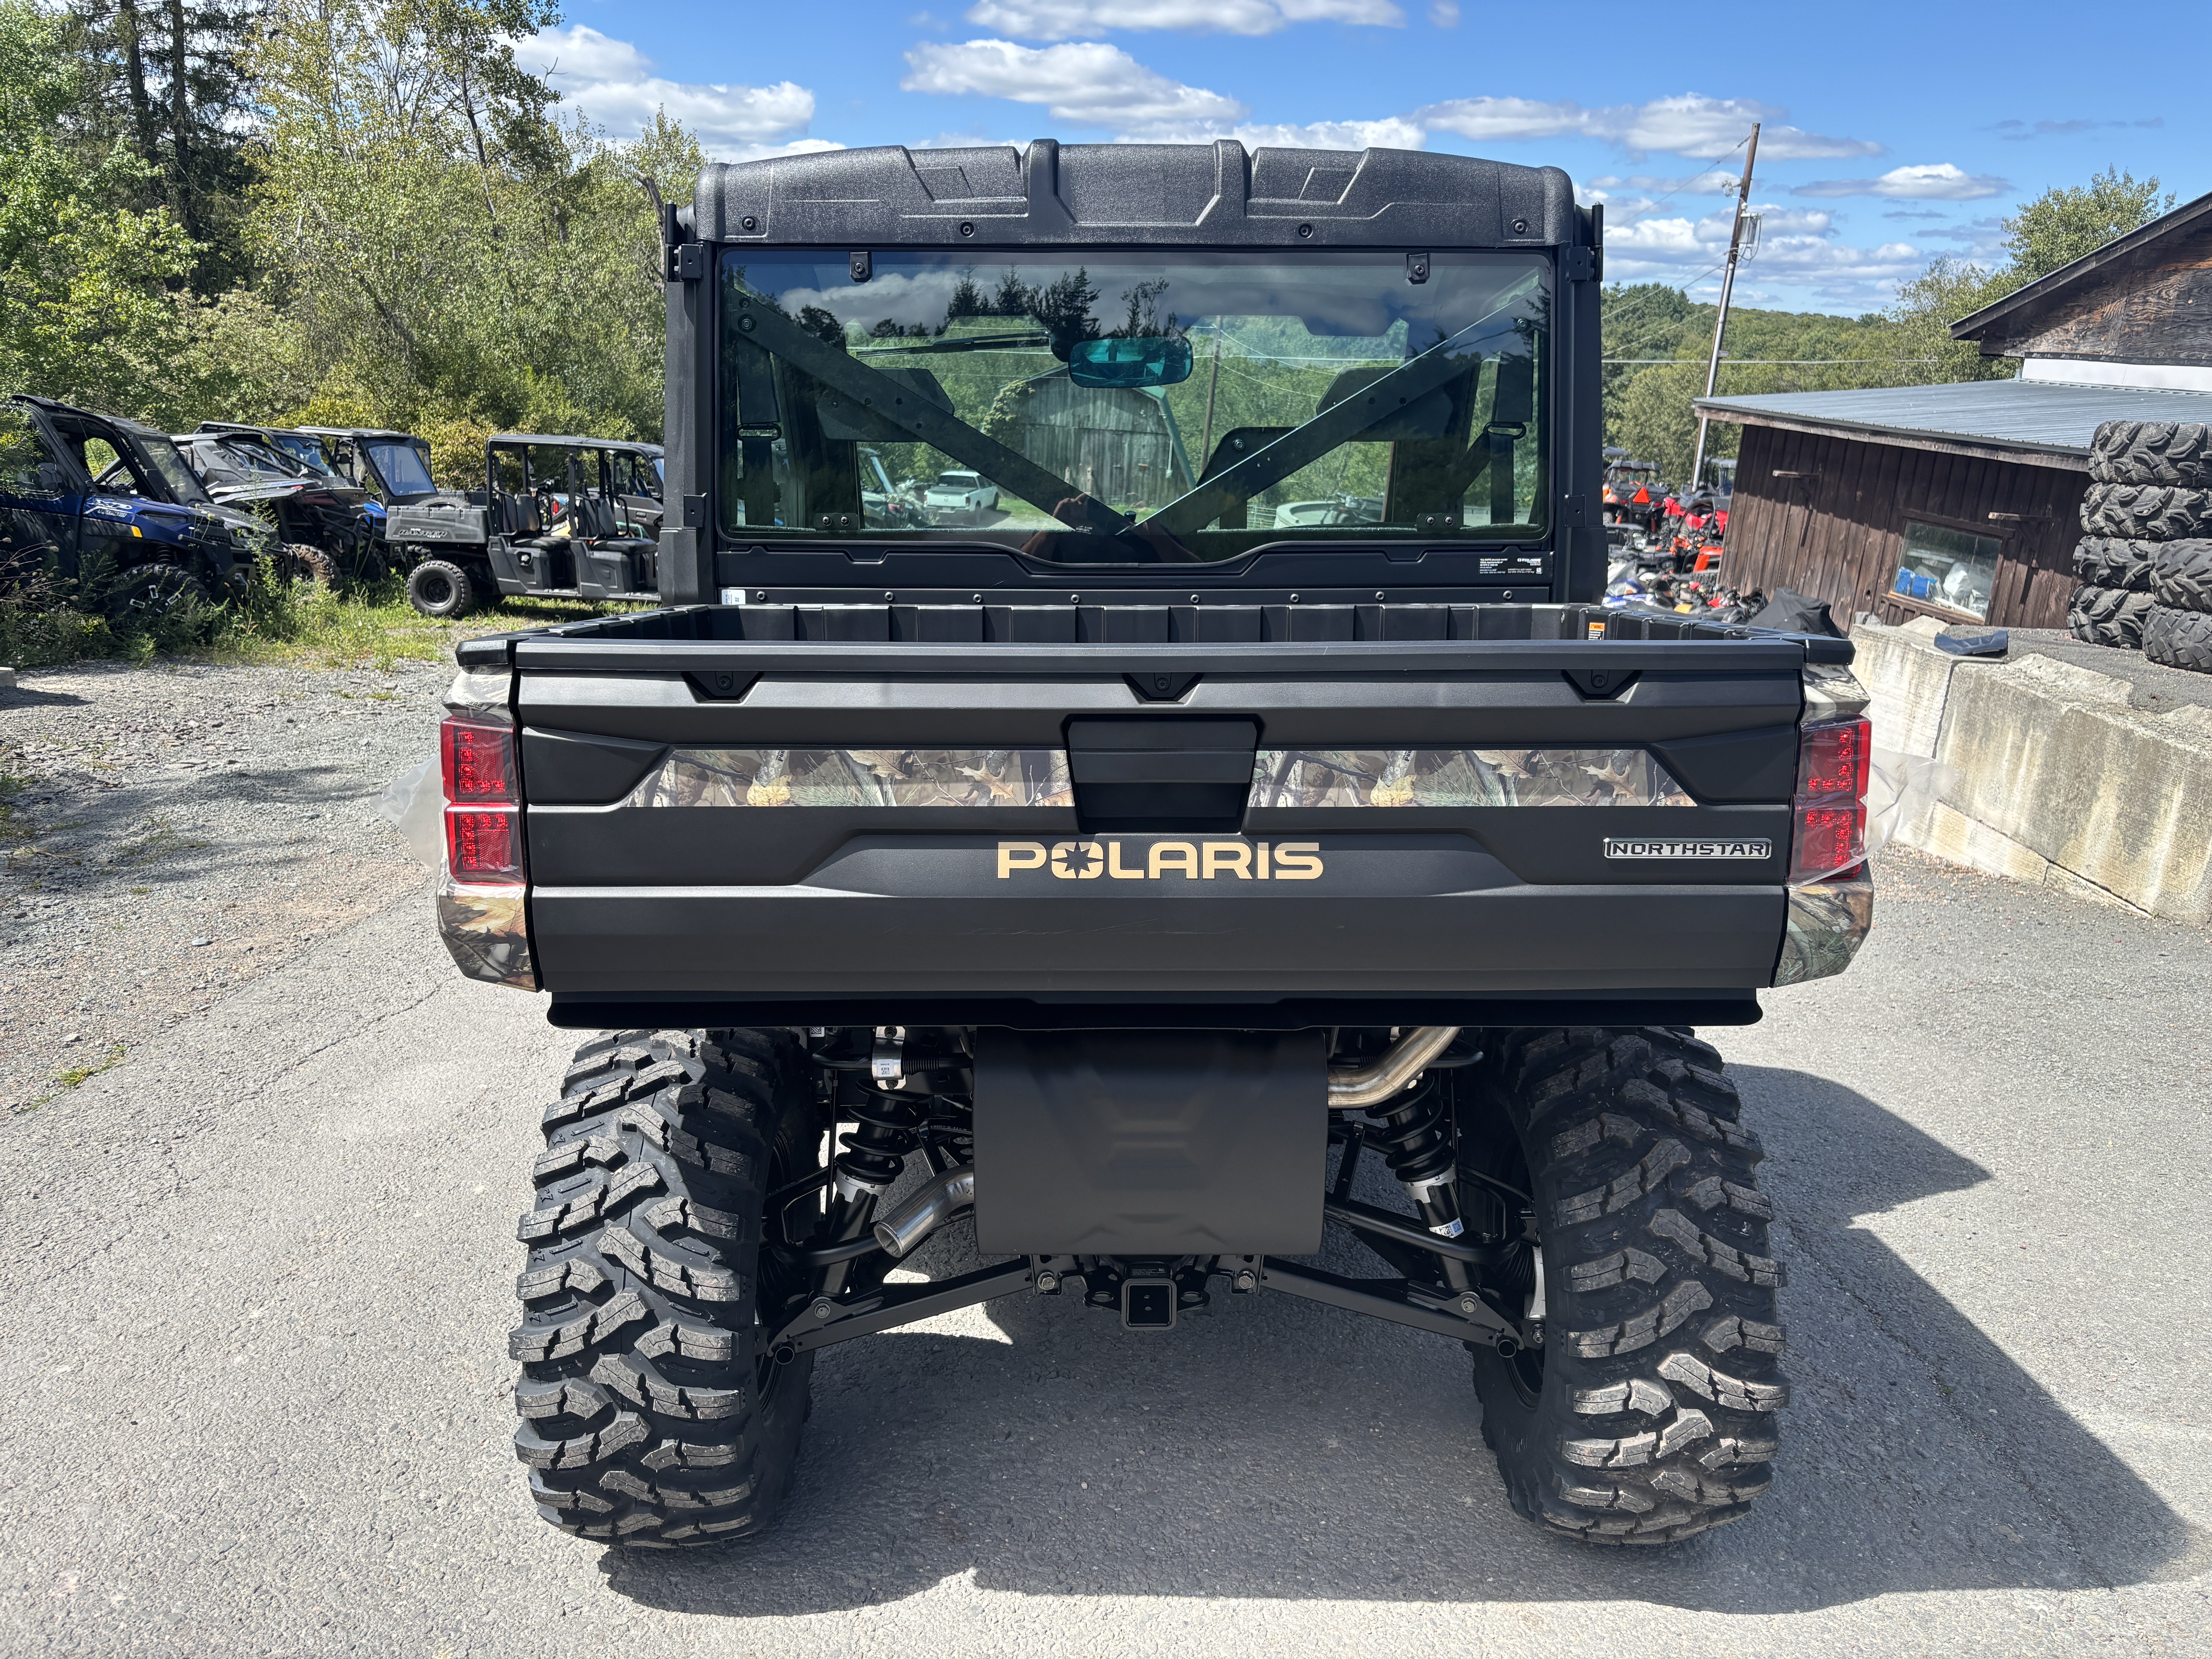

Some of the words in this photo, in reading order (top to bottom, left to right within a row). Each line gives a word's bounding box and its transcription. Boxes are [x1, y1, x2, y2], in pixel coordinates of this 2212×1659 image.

[86, 499, 132, 509] XP
[1612, 843, 1764, 855] NORTHSTAR
[998, 842, 1323, 879] POLARIS
